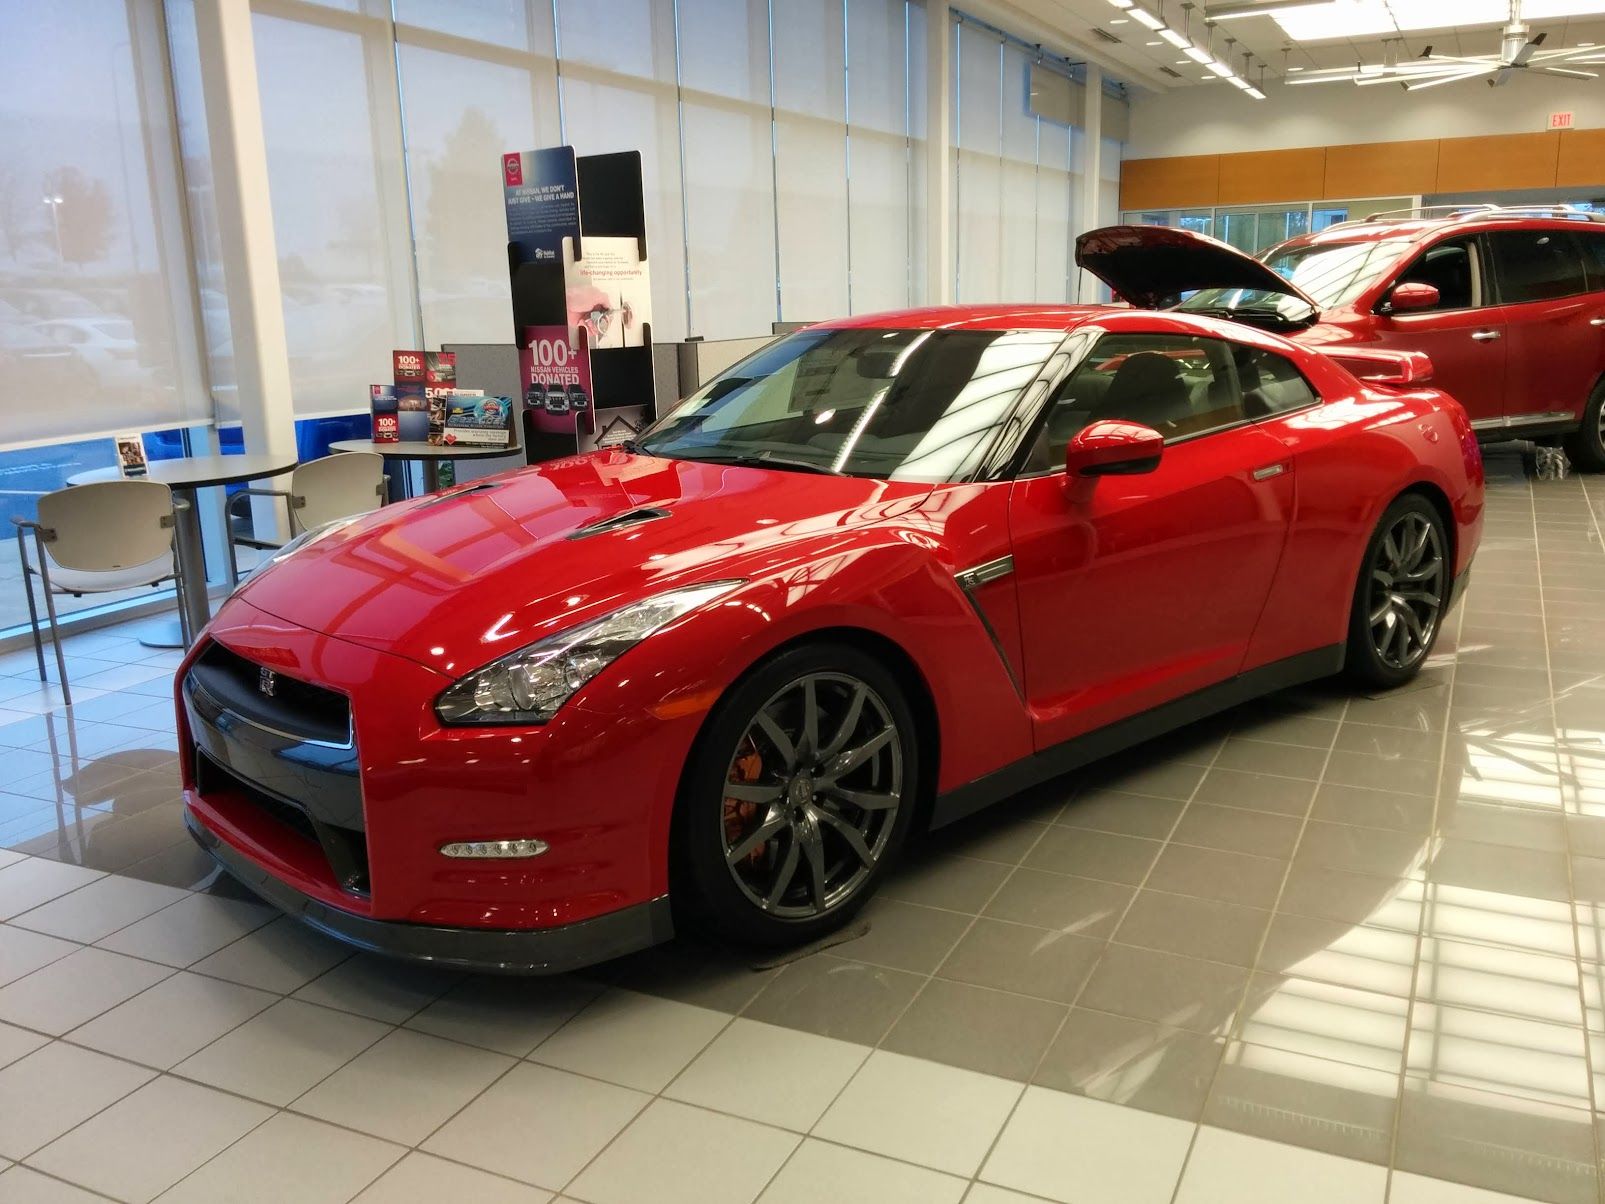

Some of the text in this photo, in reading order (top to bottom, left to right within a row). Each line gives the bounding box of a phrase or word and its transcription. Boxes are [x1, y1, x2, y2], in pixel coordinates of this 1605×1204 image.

[1552, 113, 1571, 127] EXIT
[508, 197, 519, 205] JUST
[528, 339, 577, 367] 100+
[398, 355, 420, 364] 100+
[530, 366, 579, 374] NISSAN VEHICLES
[531, 373, 580, 385] DONATED
[378, 418, 396, 426] 100+
